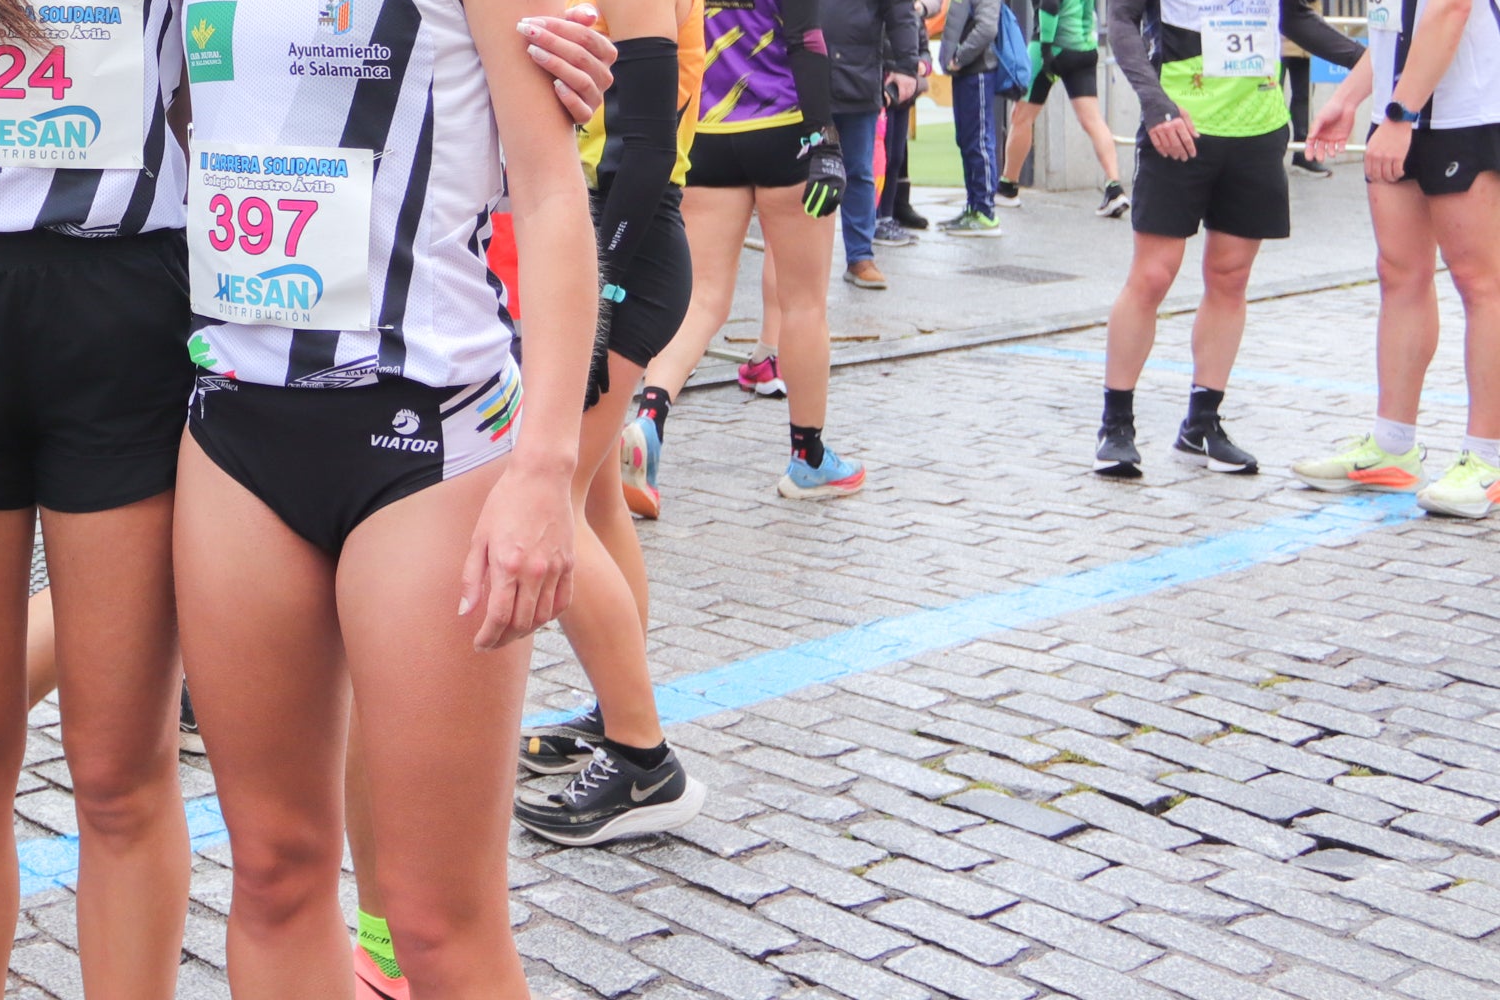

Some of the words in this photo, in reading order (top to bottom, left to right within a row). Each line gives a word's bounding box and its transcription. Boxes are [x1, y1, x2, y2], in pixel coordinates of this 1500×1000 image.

[39, 5, 122, 24] SOLIDARIA
[70, 25, 111, 40] Ávila
[288, 42, 391, 61] Ayuntamiento
[1227, 33, 1254, 53] 31
[289, 60, 305, 75] de
[309, 60, 391, 79] Salamanca
[200, 152, 209, 170] III
[210, 153, 261, 175] CARRERA
[263, 156, 349, 178] SOLIDARIA
[203, 174, 236, 190] Colegio
[237, 176, 291, 191] Maestro
[293, 177, 336, 194] Ávila
[208, 193, 319, 257] 397
[214, 272, 310, 311] HESAN
[219, 303, 311, 323] DISTRIBUCIÓN
[369, 434, 439, 454] VIATOR
